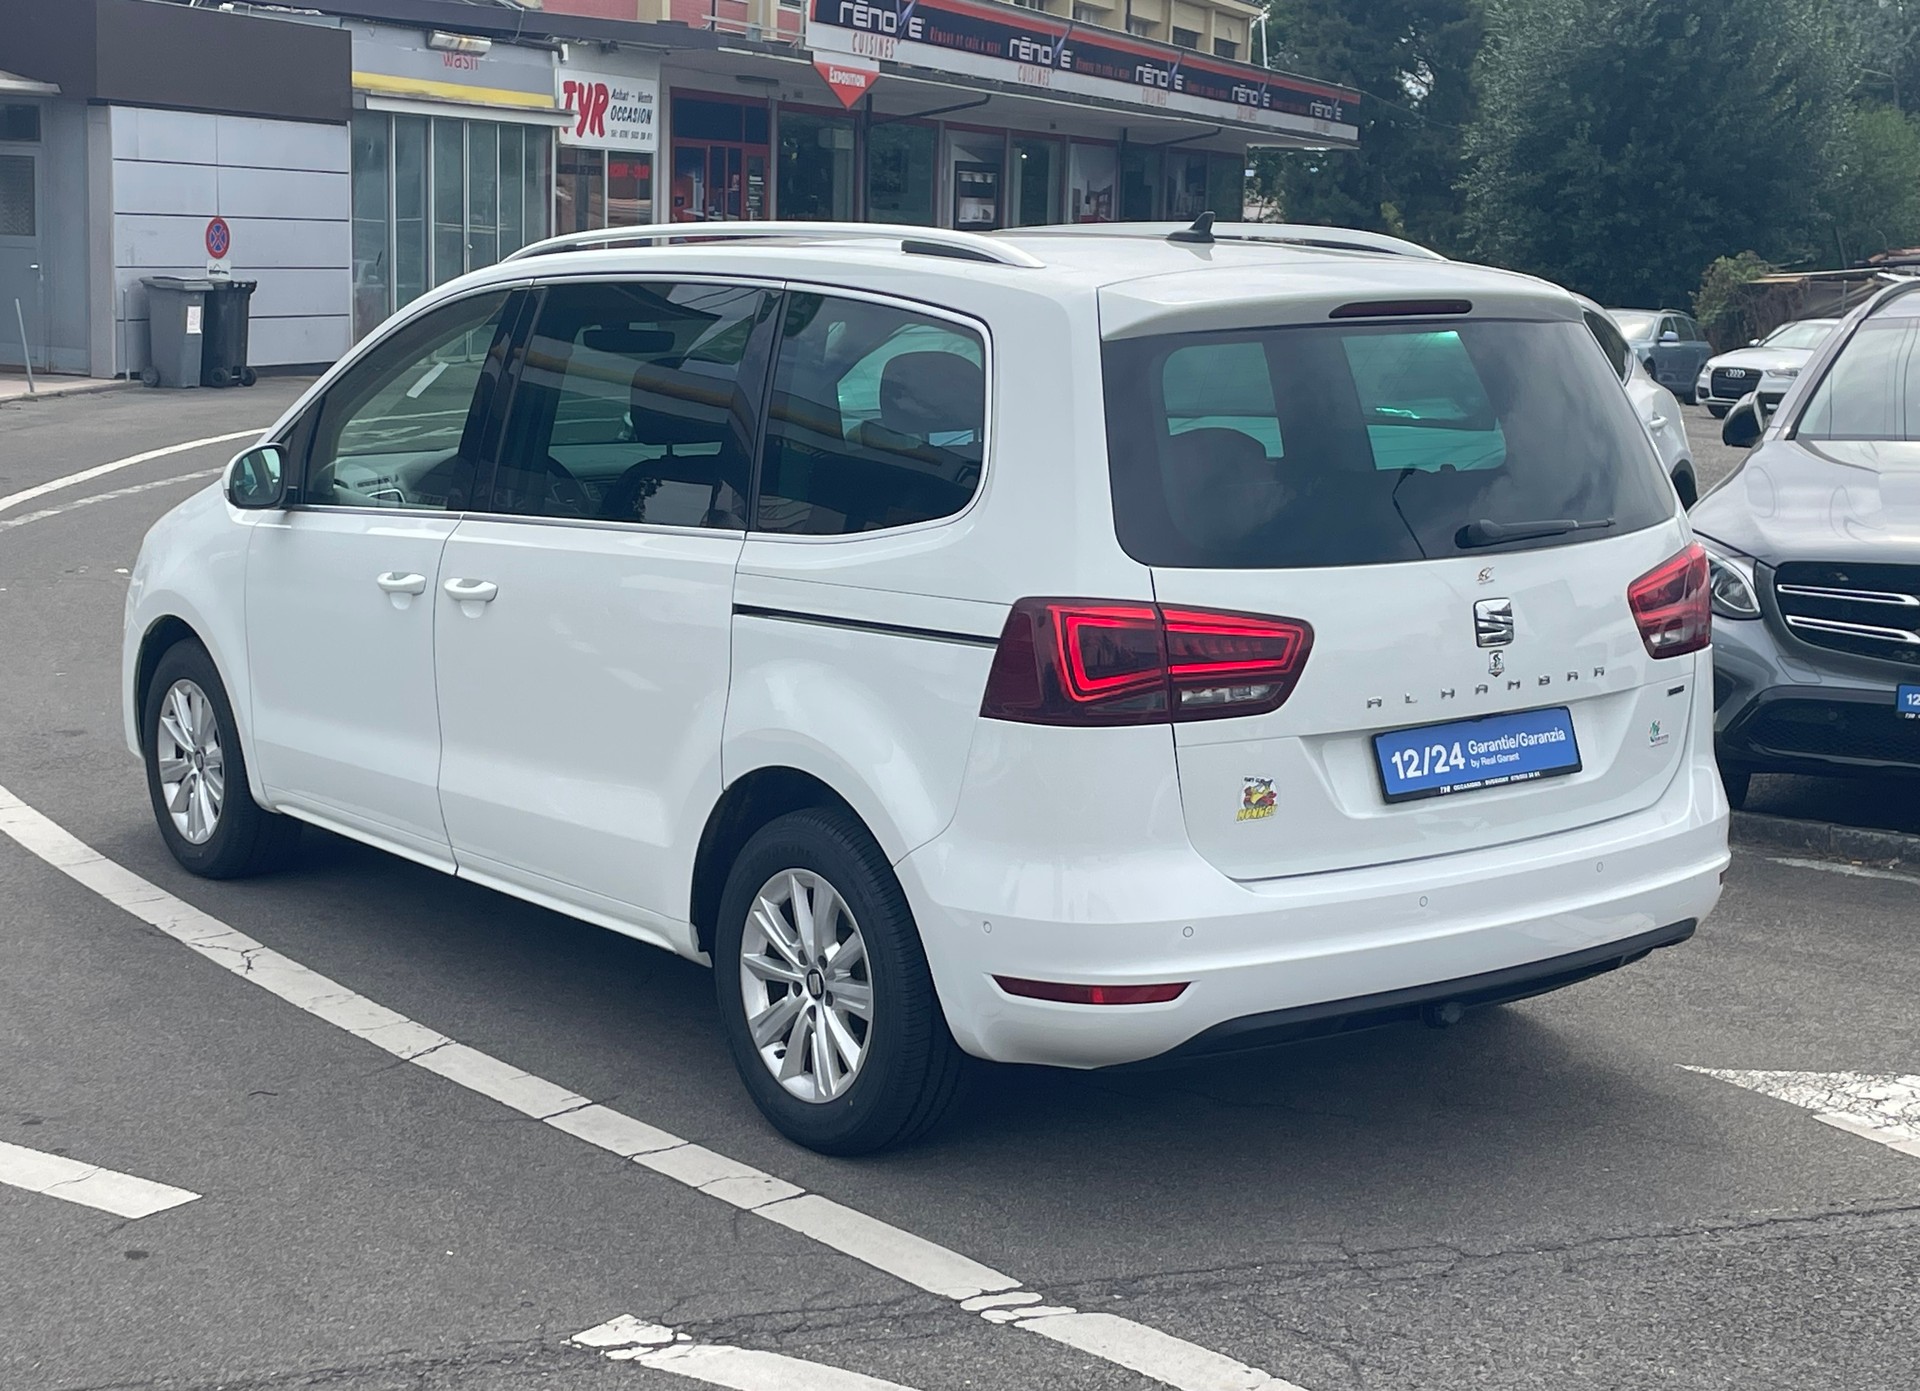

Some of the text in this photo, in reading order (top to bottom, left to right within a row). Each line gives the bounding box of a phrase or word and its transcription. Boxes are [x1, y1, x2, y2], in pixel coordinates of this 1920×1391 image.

[852, 33, 896, 58] CUISINES
[562, 80, 609, 138] TYR
[610, 105, 653, 124] OCCASION
[1366, 666, 1605, 708] ALHAMBRA
[1391, 727, 1567, 780] 12/24 Garantie/Garanzia
[1470, 752, 1520, 769] by Real Garant
